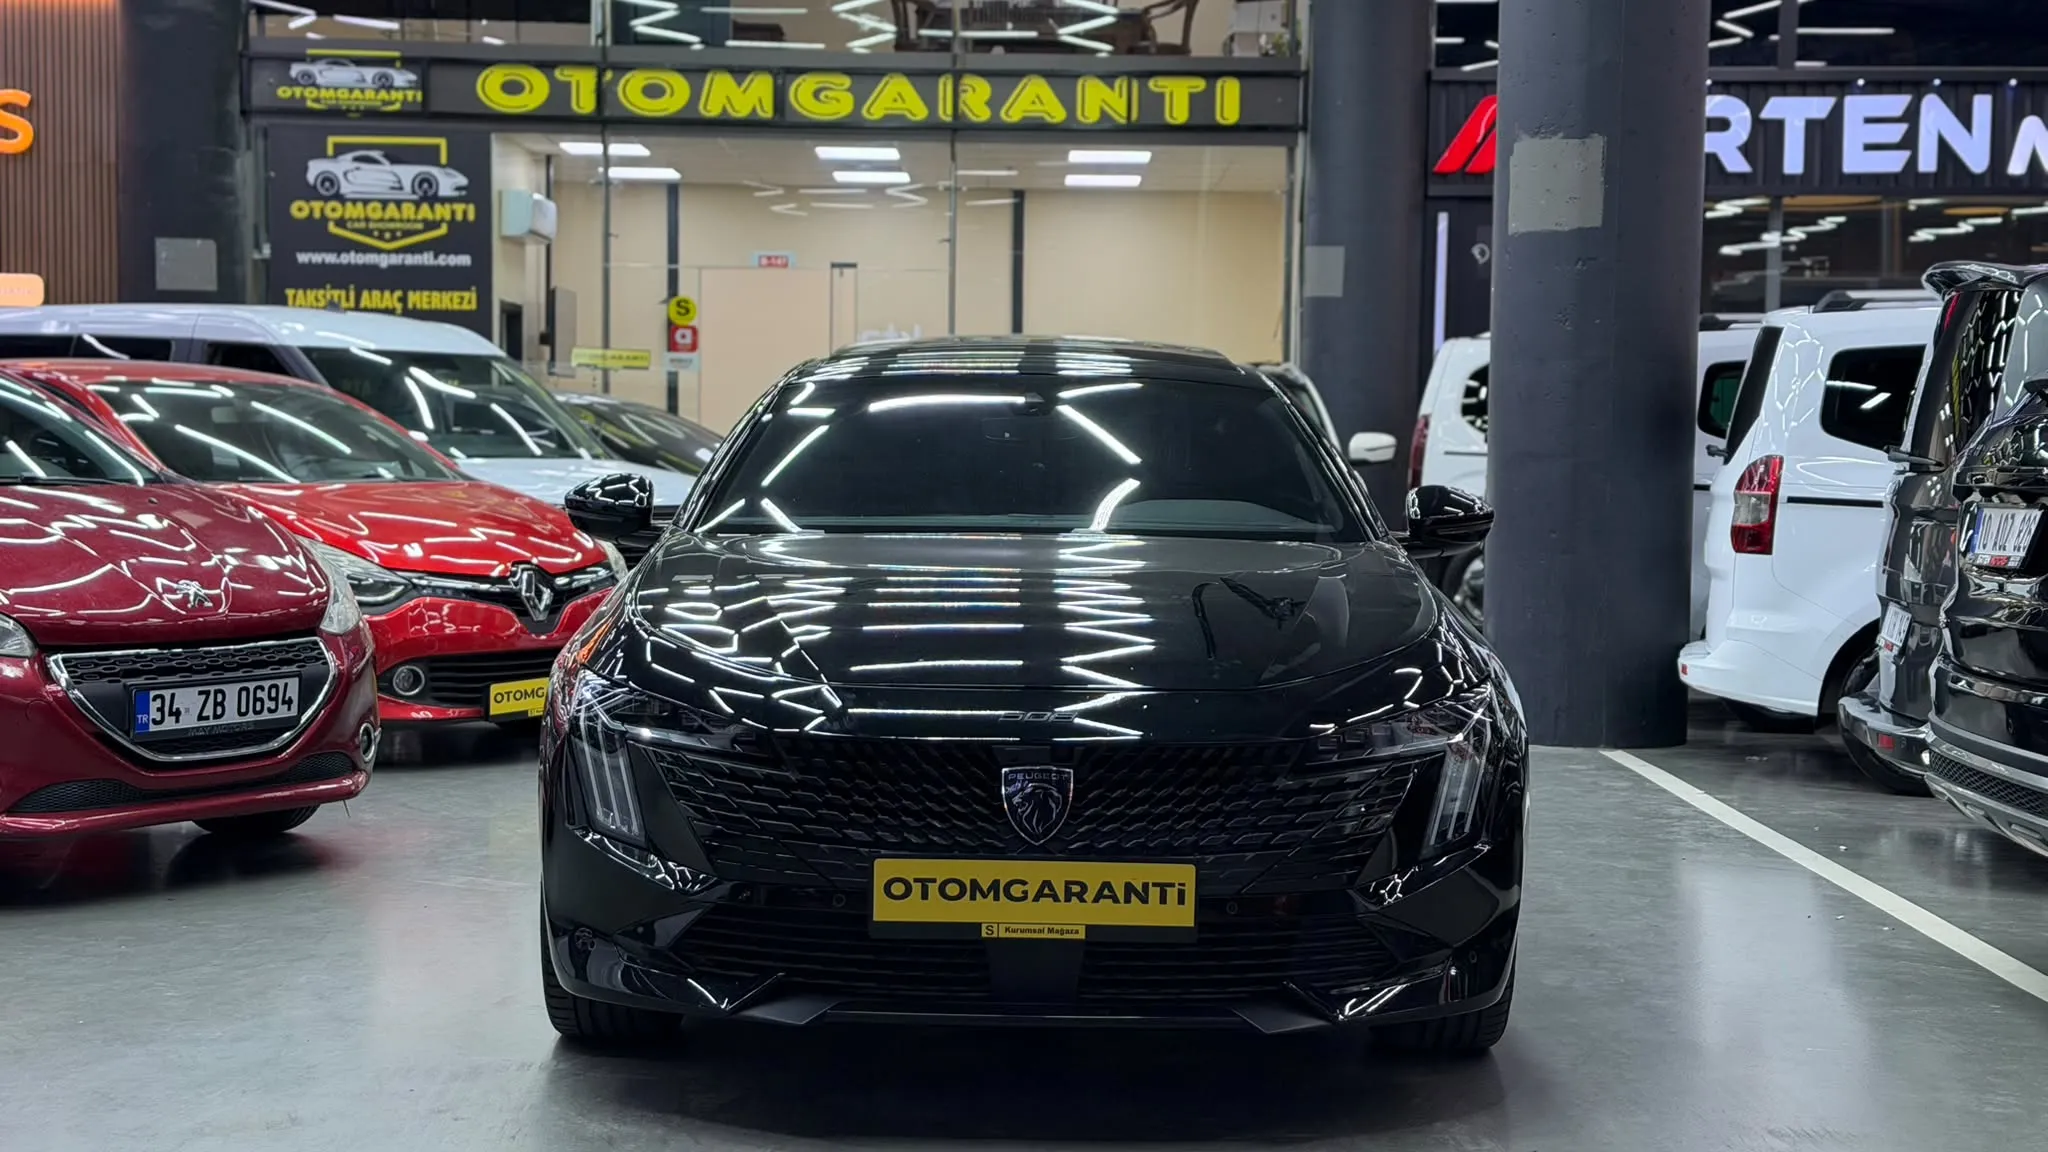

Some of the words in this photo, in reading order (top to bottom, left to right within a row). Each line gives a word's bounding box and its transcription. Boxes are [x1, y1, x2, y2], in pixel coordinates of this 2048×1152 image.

[276, 86, 423, 103] OTOMGARANTI
[475, 63, 1241, 125] OTOMGARANTI
[290, 200, 476, 221] OTOMGARANTI
[296, 250, 471, 268] www.otomgaranti.com
[360, 289, 402, 314] ARAÇ
[407, 286, 477, 311] MERKEZİ
[675, 298, 691, 317] S
[151, 692, 182, 726] 34
[197, 688, 226, 722] ZB
[237, 682, 294, 718] 0694
[136, 714, 149, 724] TR
[985, 925, 995, 936] S
[1004, 926, 1045, 935] Kurumsal
